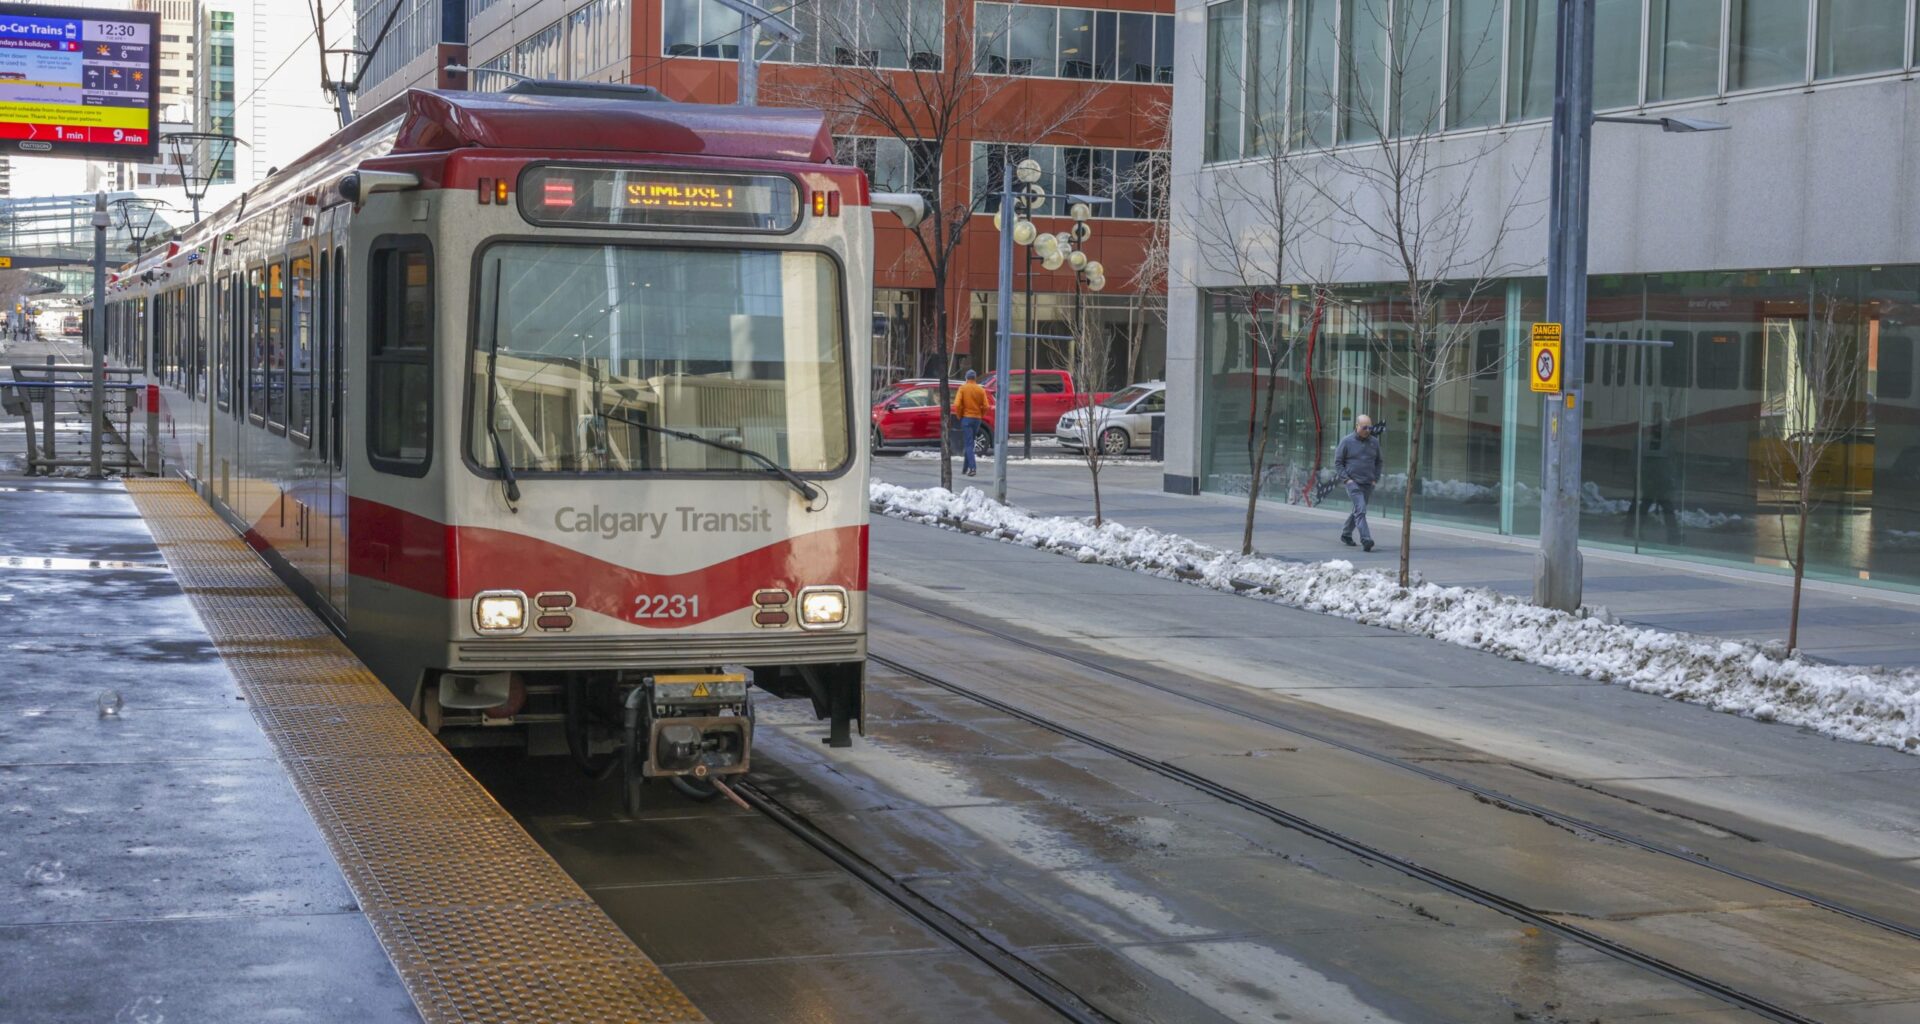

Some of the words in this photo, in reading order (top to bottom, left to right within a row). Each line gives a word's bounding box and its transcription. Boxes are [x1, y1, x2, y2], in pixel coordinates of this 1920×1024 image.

[30, 24, 63, 35] Trains
[98, 24, 135, 37] 12:30
[24, 40, 52, 49] holidays.
[121, 50, 128, 59] 6
[55, 126, 63, 139] 1
[66, 132, 84, 140] min
[113, 129, 124, 142] 9
[125, 134, 142, 143] min
[1534, 326, 1560, 335] DANGER
[554, 505, 668, 540] Calgary
[675, 505, 772, 533] Transit
[634, 594, 700, 619] 2231
